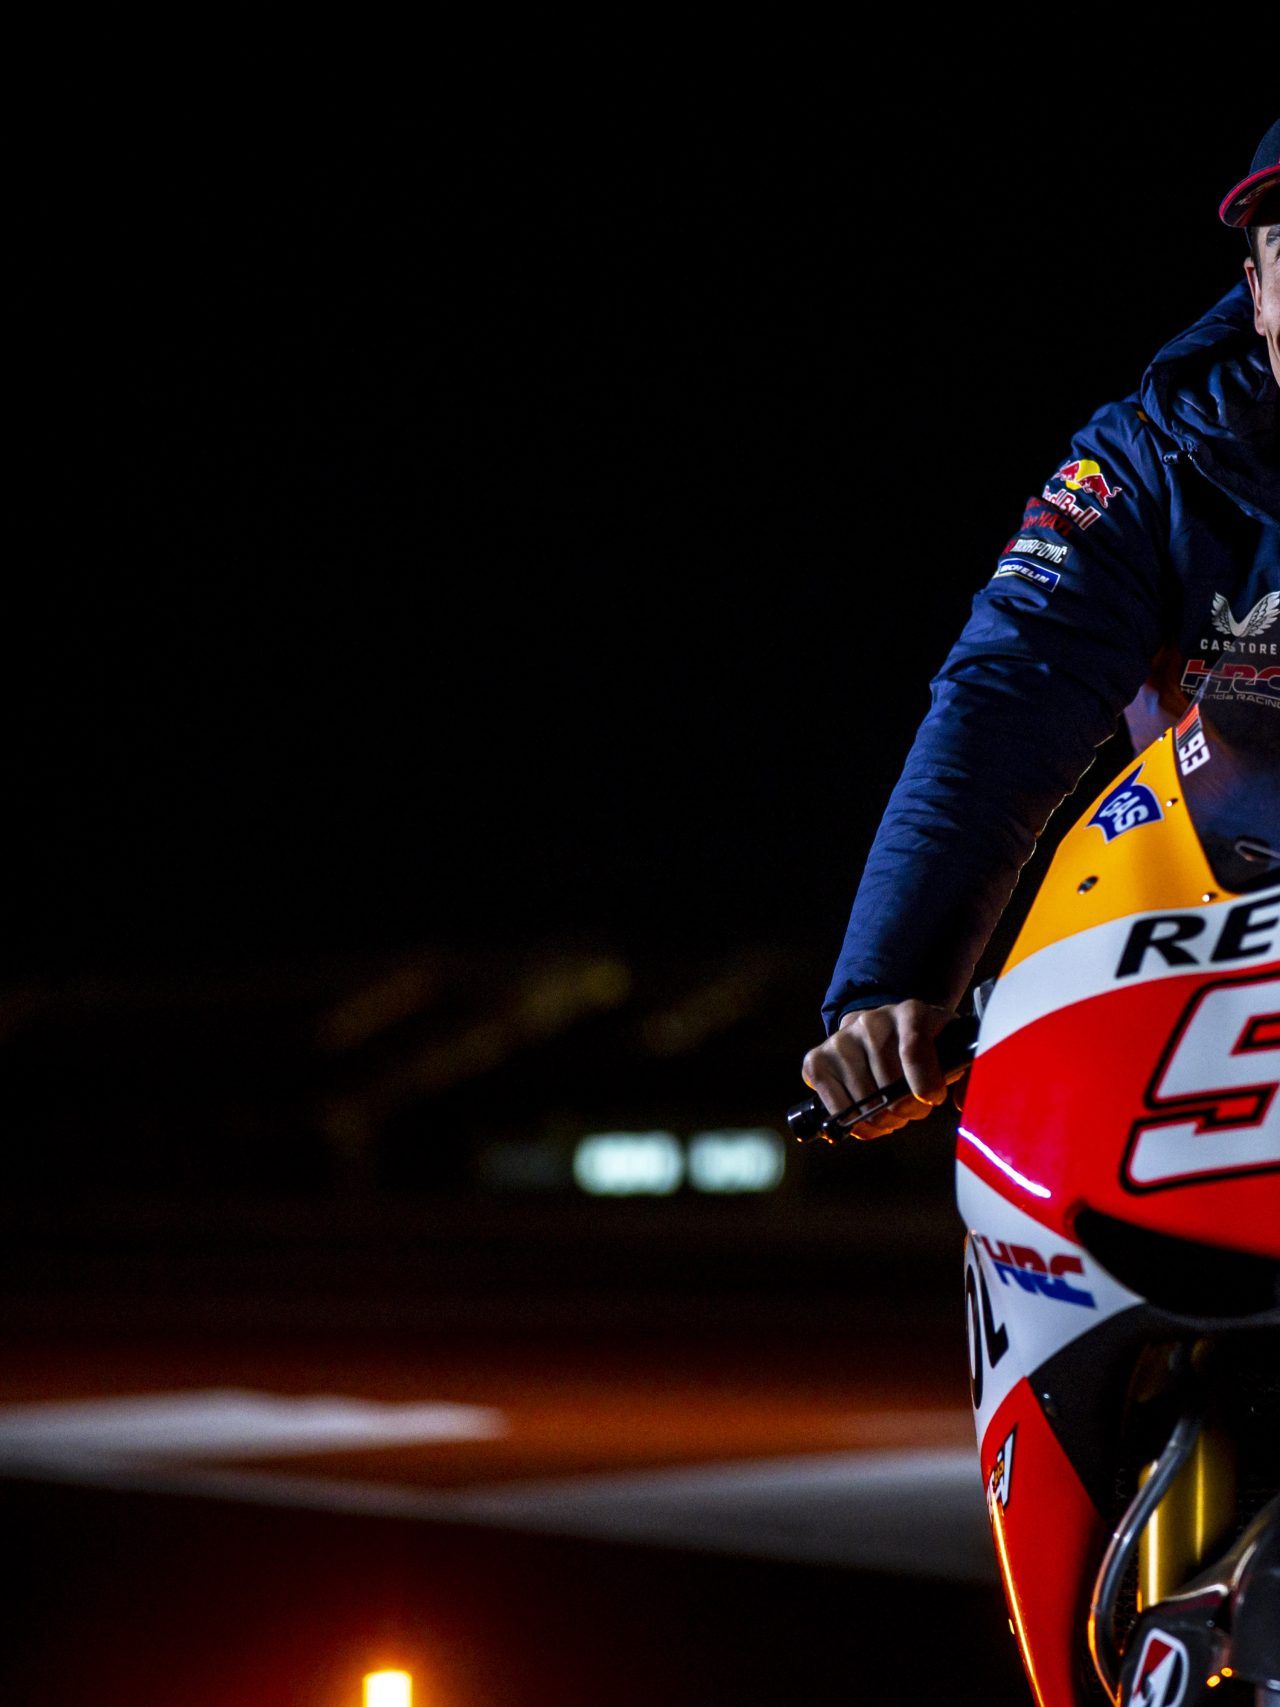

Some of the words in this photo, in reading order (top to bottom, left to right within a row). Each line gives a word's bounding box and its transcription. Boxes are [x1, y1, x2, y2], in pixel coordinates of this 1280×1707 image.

[1059, 491, 1102, 531] Bull
[1200, 638, 1278, 655] CASTORE
[1178, 730, 1211, 776] 93
[1099, 791, 1149, 833] GAS
[980, 1235, 1098, 1310] HRC
